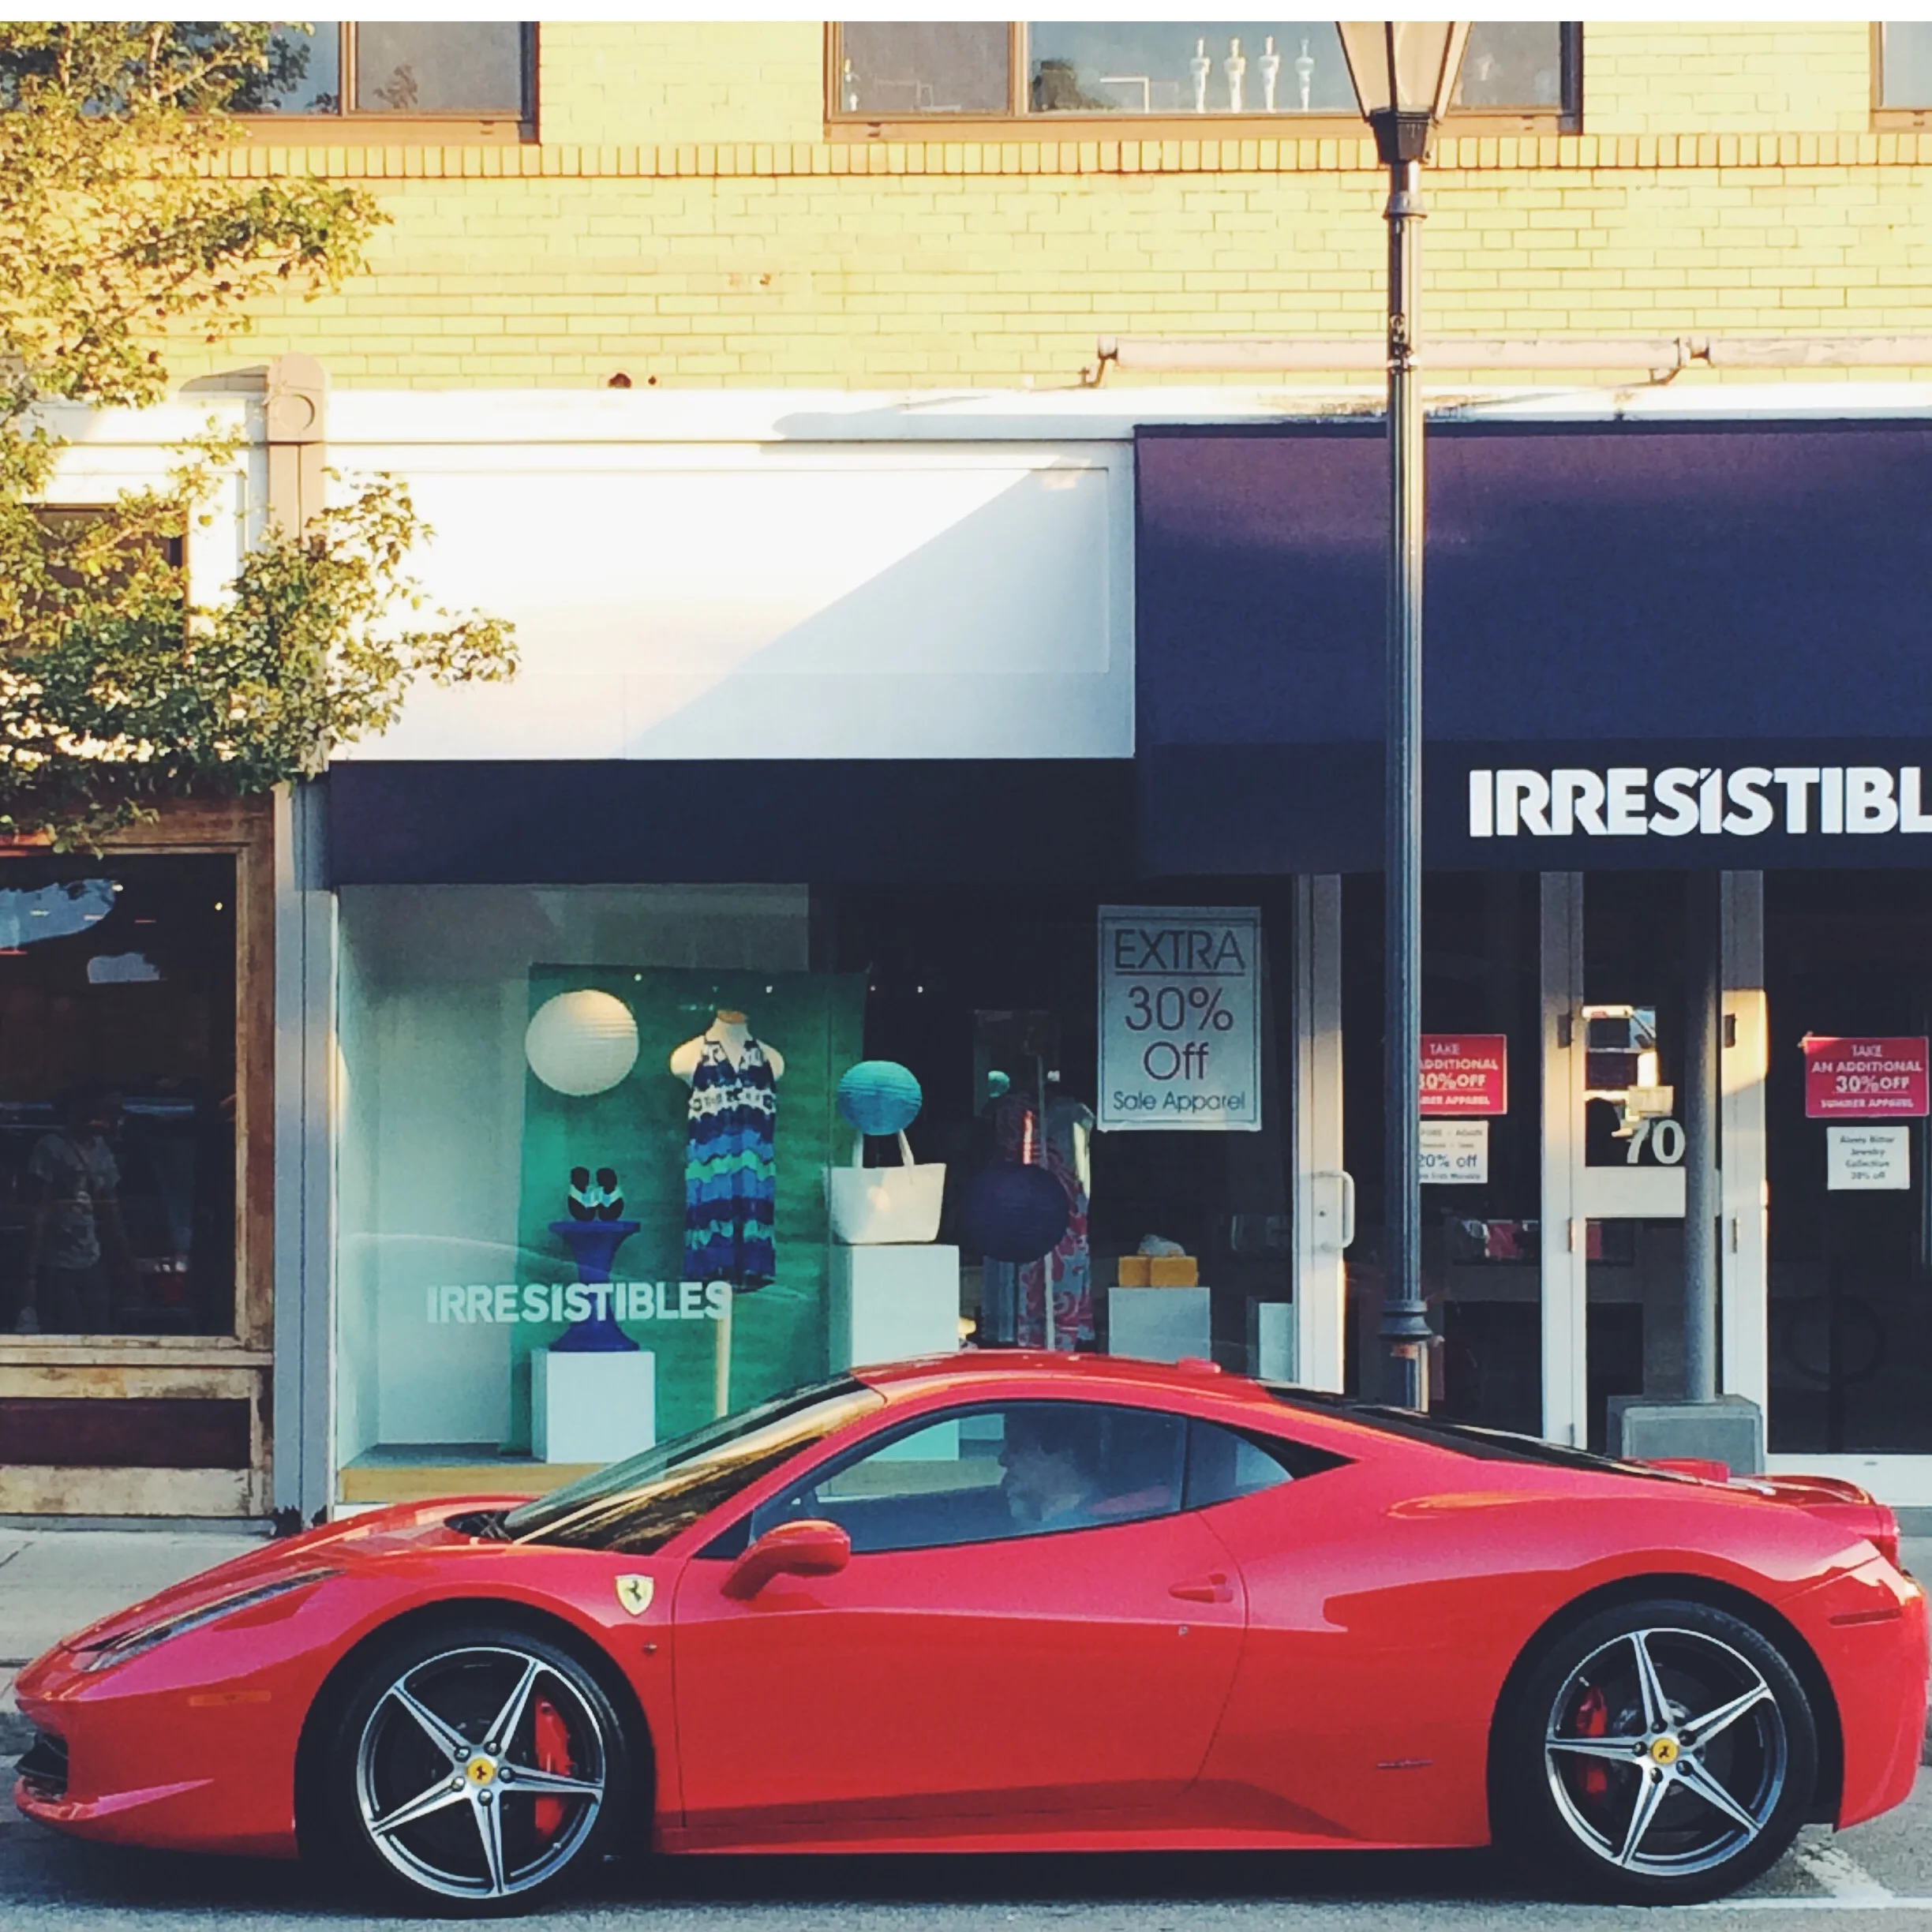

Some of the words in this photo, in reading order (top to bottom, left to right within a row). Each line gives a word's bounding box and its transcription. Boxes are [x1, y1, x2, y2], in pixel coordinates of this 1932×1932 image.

[1469, 767, 1932, 837] IRRESISTIBL
[1114, 929, 1246, 970] EXTRA
[1124, 986, 1234, 1032] 30%
[1429, 1043, 1460, 1055] TAKE
[1851, 1044, 1883, 1058] TAKE
[1143, 1041, 1210, 1081] Off
[1811, 1061, 1833, 1073] AN
[1836, 1061, 1923, 1073] ADDITIONAL
[1113, 1091, 1157, 1111] Sale
[1163, 1091, 1246, 1114] Apparel
[1445, 1095, 1491, 1106] APPAREL
[1820, 1098, 1866, 1109] SUMMER
[1868, 1098, 1915, 1109] APPAREL
[1625, 1118, 1686, 1165] 70
[1455, 1154, 1477, 1167] off
[426, 1281, 733, 1324] IRRESISTIBLES
